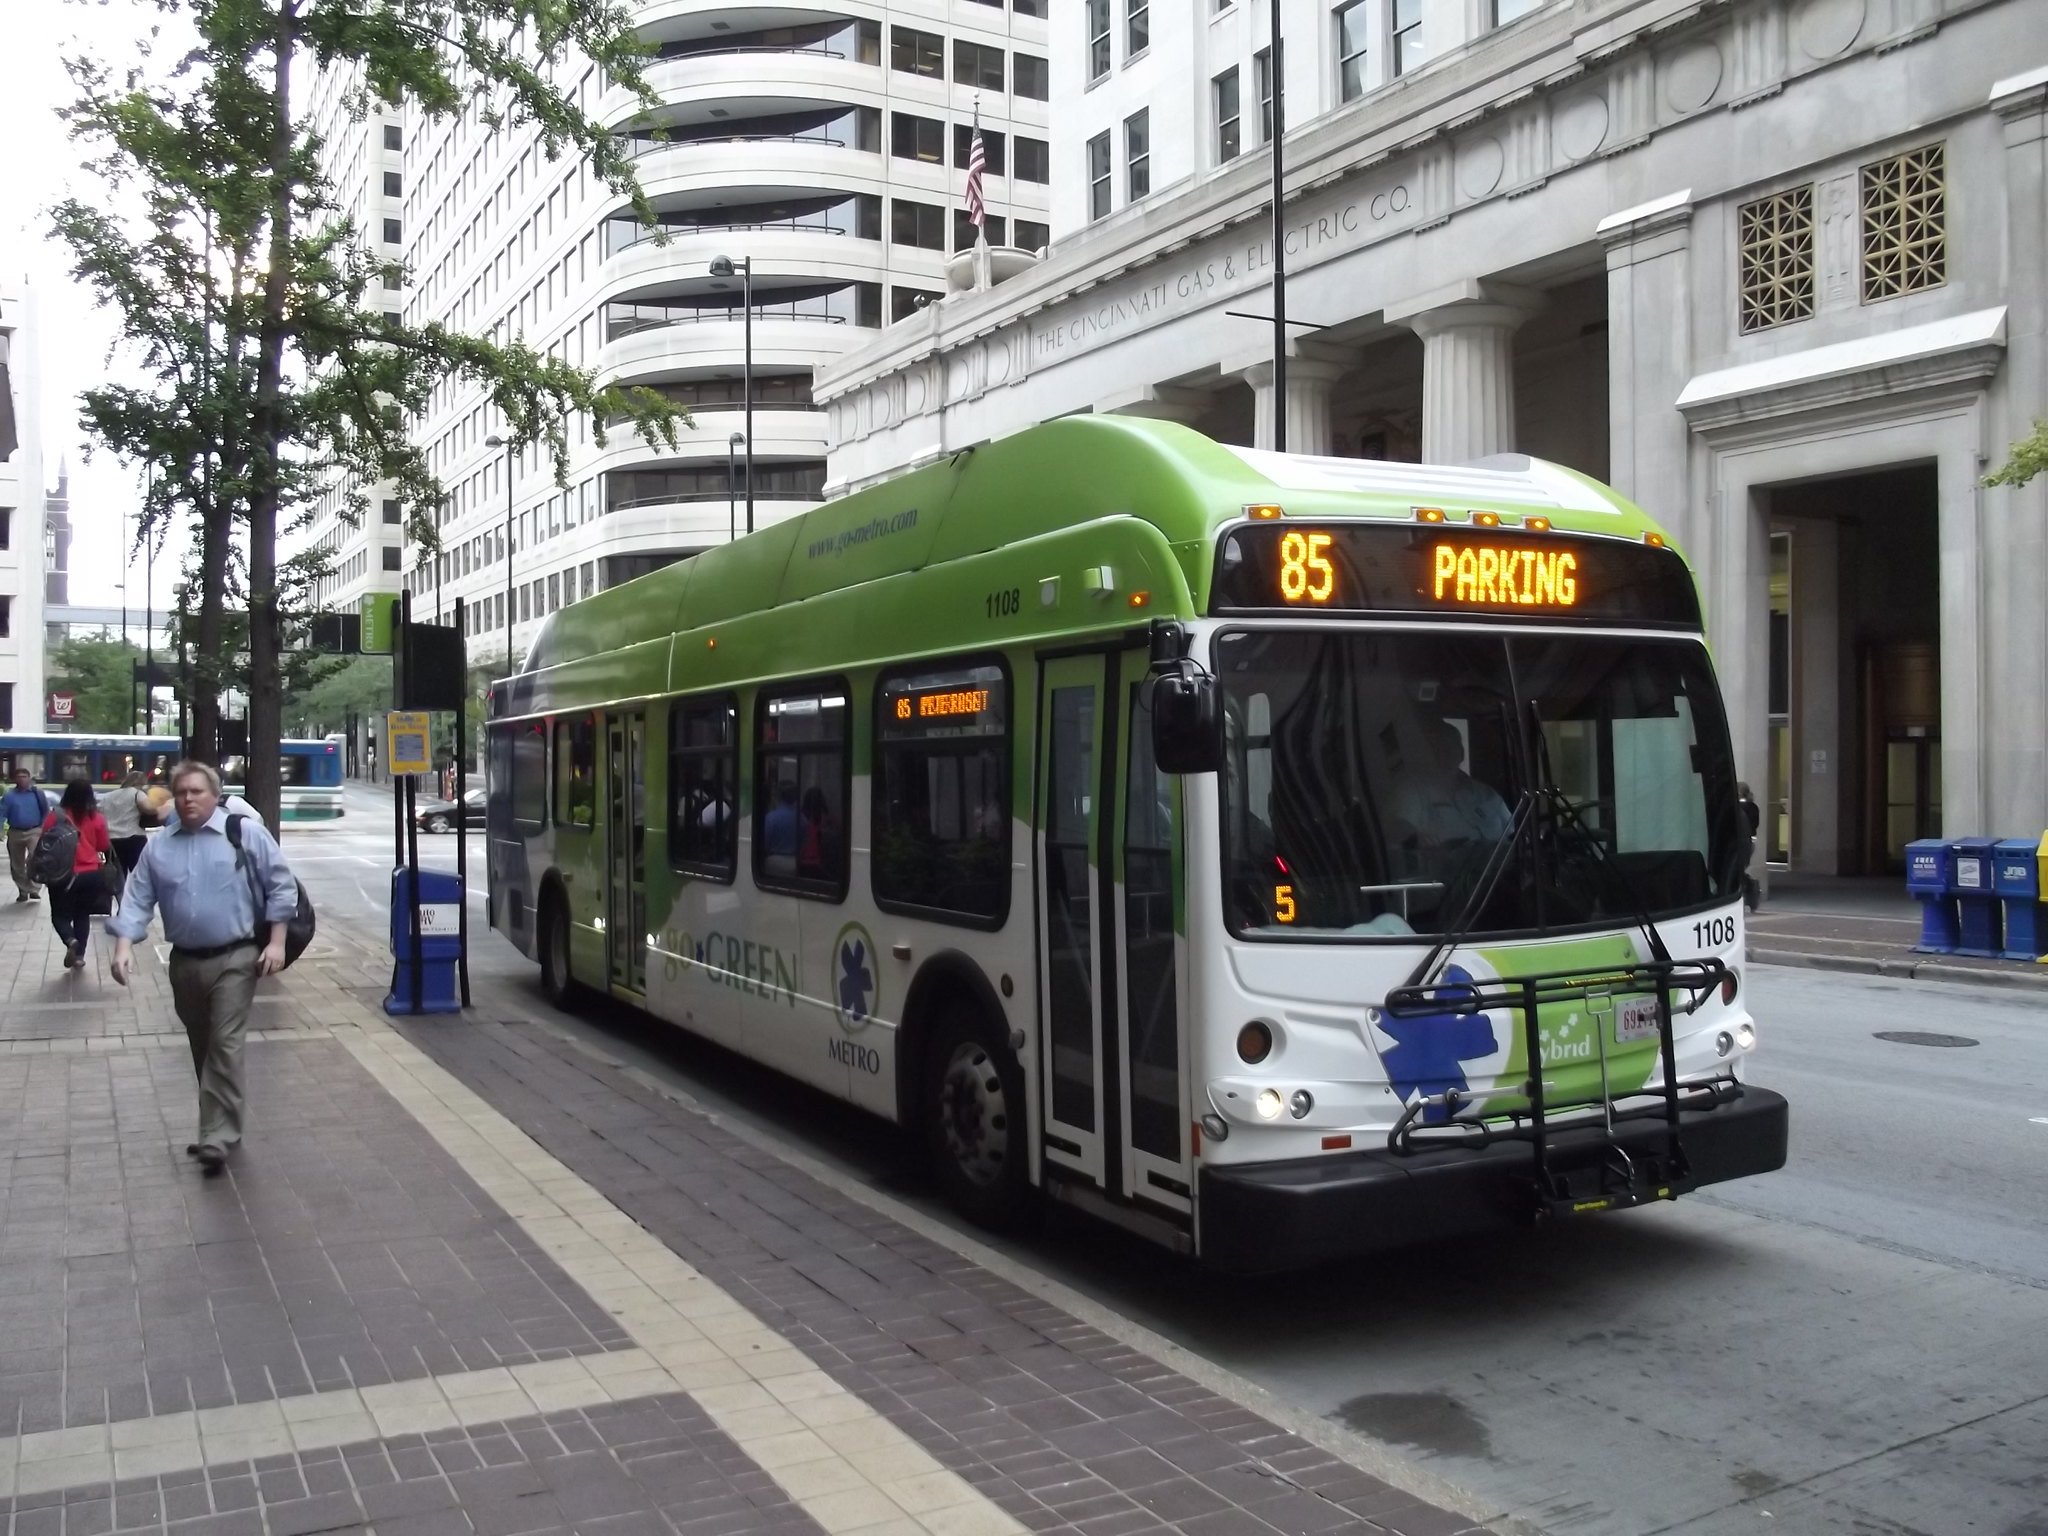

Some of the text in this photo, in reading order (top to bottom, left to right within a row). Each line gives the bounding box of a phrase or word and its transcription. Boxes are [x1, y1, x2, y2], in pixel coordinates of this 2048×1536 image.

[1036, 184, 1413, 355] THE CINCINNATI GAS & ELCTRIC CO.
[808, 508, 919, 560] www.go-metro.com
[1281, 532, 1577, 605] 85 PARKING
[986, 587, 1020, 619] 1108
[365, 609, 375, 650] METRO
[897, 698, 911, 719] 85
[1275, 885, 1295, 922] 5
[1693, 916, 1735, 949] 1108
[664, 927, 797, 1008] go GREEN
[828, 1036, 881, 1076] METRO
[1540, 1034, 1590, 1067] ybrid
